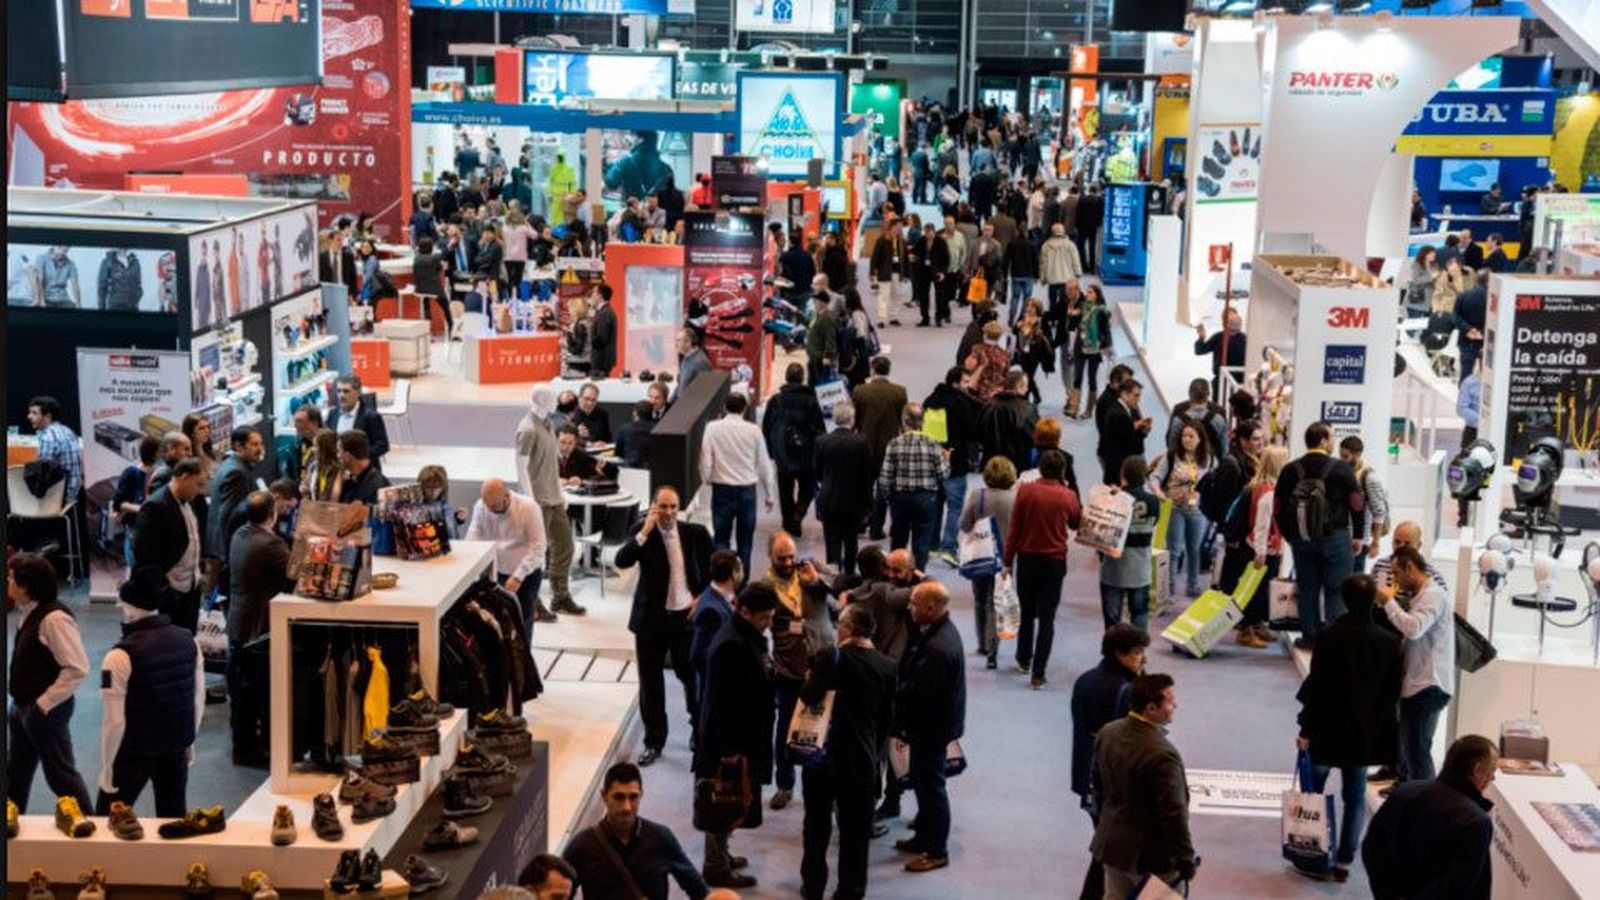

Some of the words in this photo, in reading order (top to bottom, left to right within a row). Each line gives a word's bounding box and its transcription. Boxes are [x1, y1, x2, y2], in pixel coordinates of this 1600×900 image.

[1289, 71, 1374, 89] PANTER
[424, 111, 503, 125] www.choiva.es
[1409, 102, 1508, 123] JUBA
[263, 149, 376, 168] PRODUCTO
[1516, 293, 1542, 311] 3M
[1327, 306, 1370, 329] 3M
[1517, 327, 1598, 348] Detenga
[1325, 354, 1365, 375] capital
[1514, 348, 1531, 364] la
[1535, 348, 1588, 366] caída
